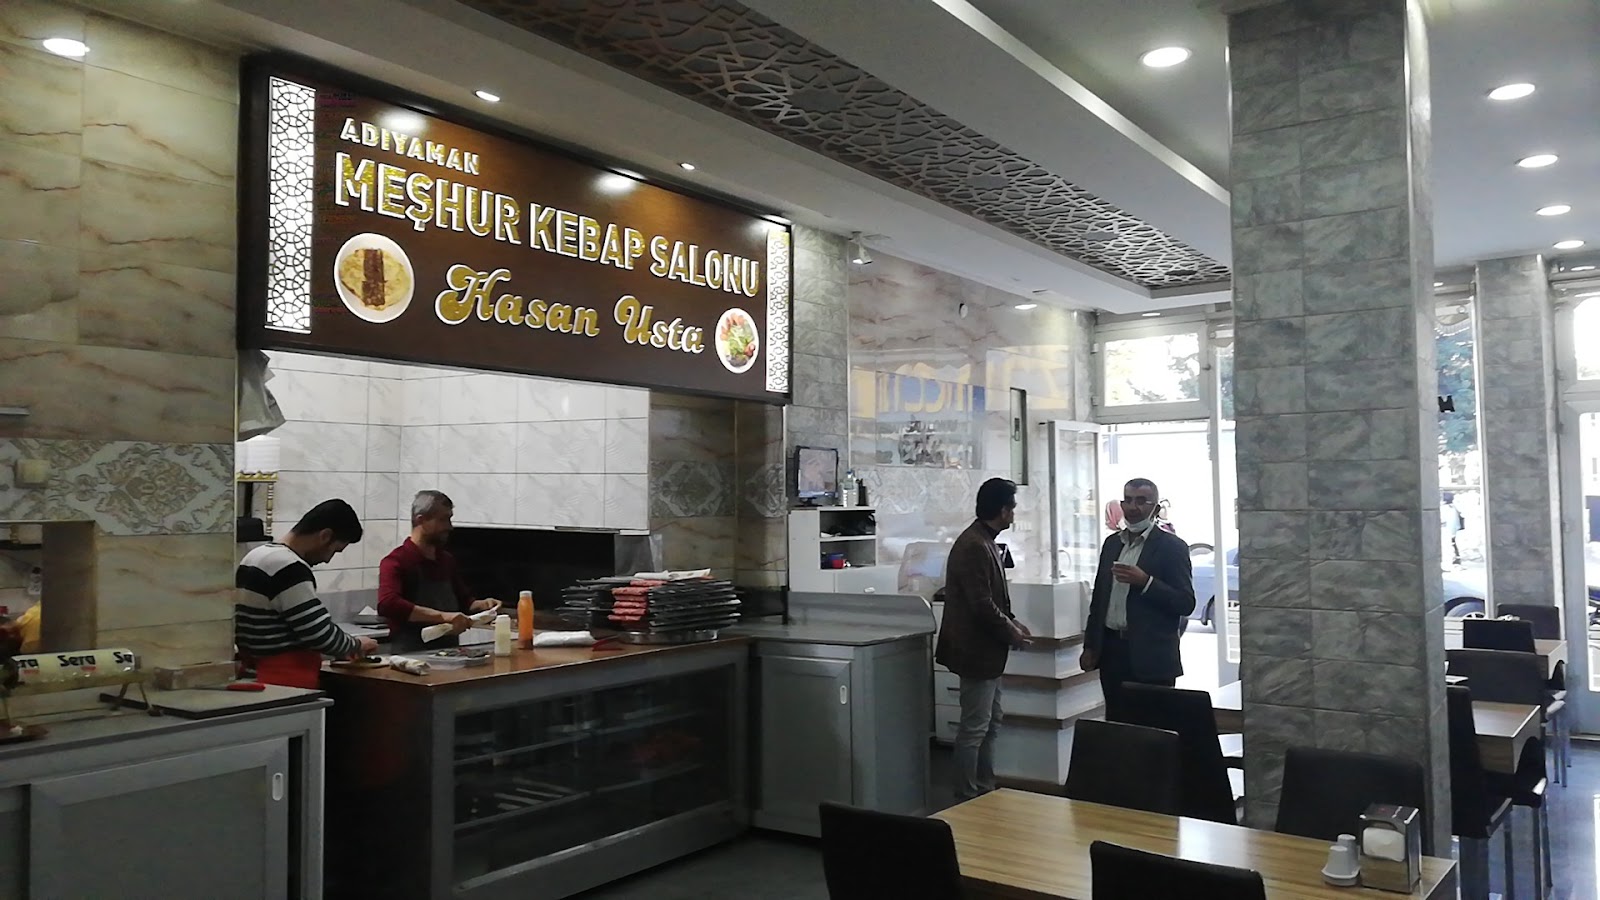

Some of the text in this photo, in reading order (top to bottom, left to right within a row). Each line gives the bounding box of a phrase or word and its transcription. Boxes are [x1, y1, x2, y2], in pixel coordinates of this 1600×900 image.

[340, 118, 480, 176] ADIYAMAN
[335, 152, 760, 297] MEŞHUR KEBAP SALONU
[434, 264, 705, 354] Hasan Usta
[57, 654, 96, 667] Sera
